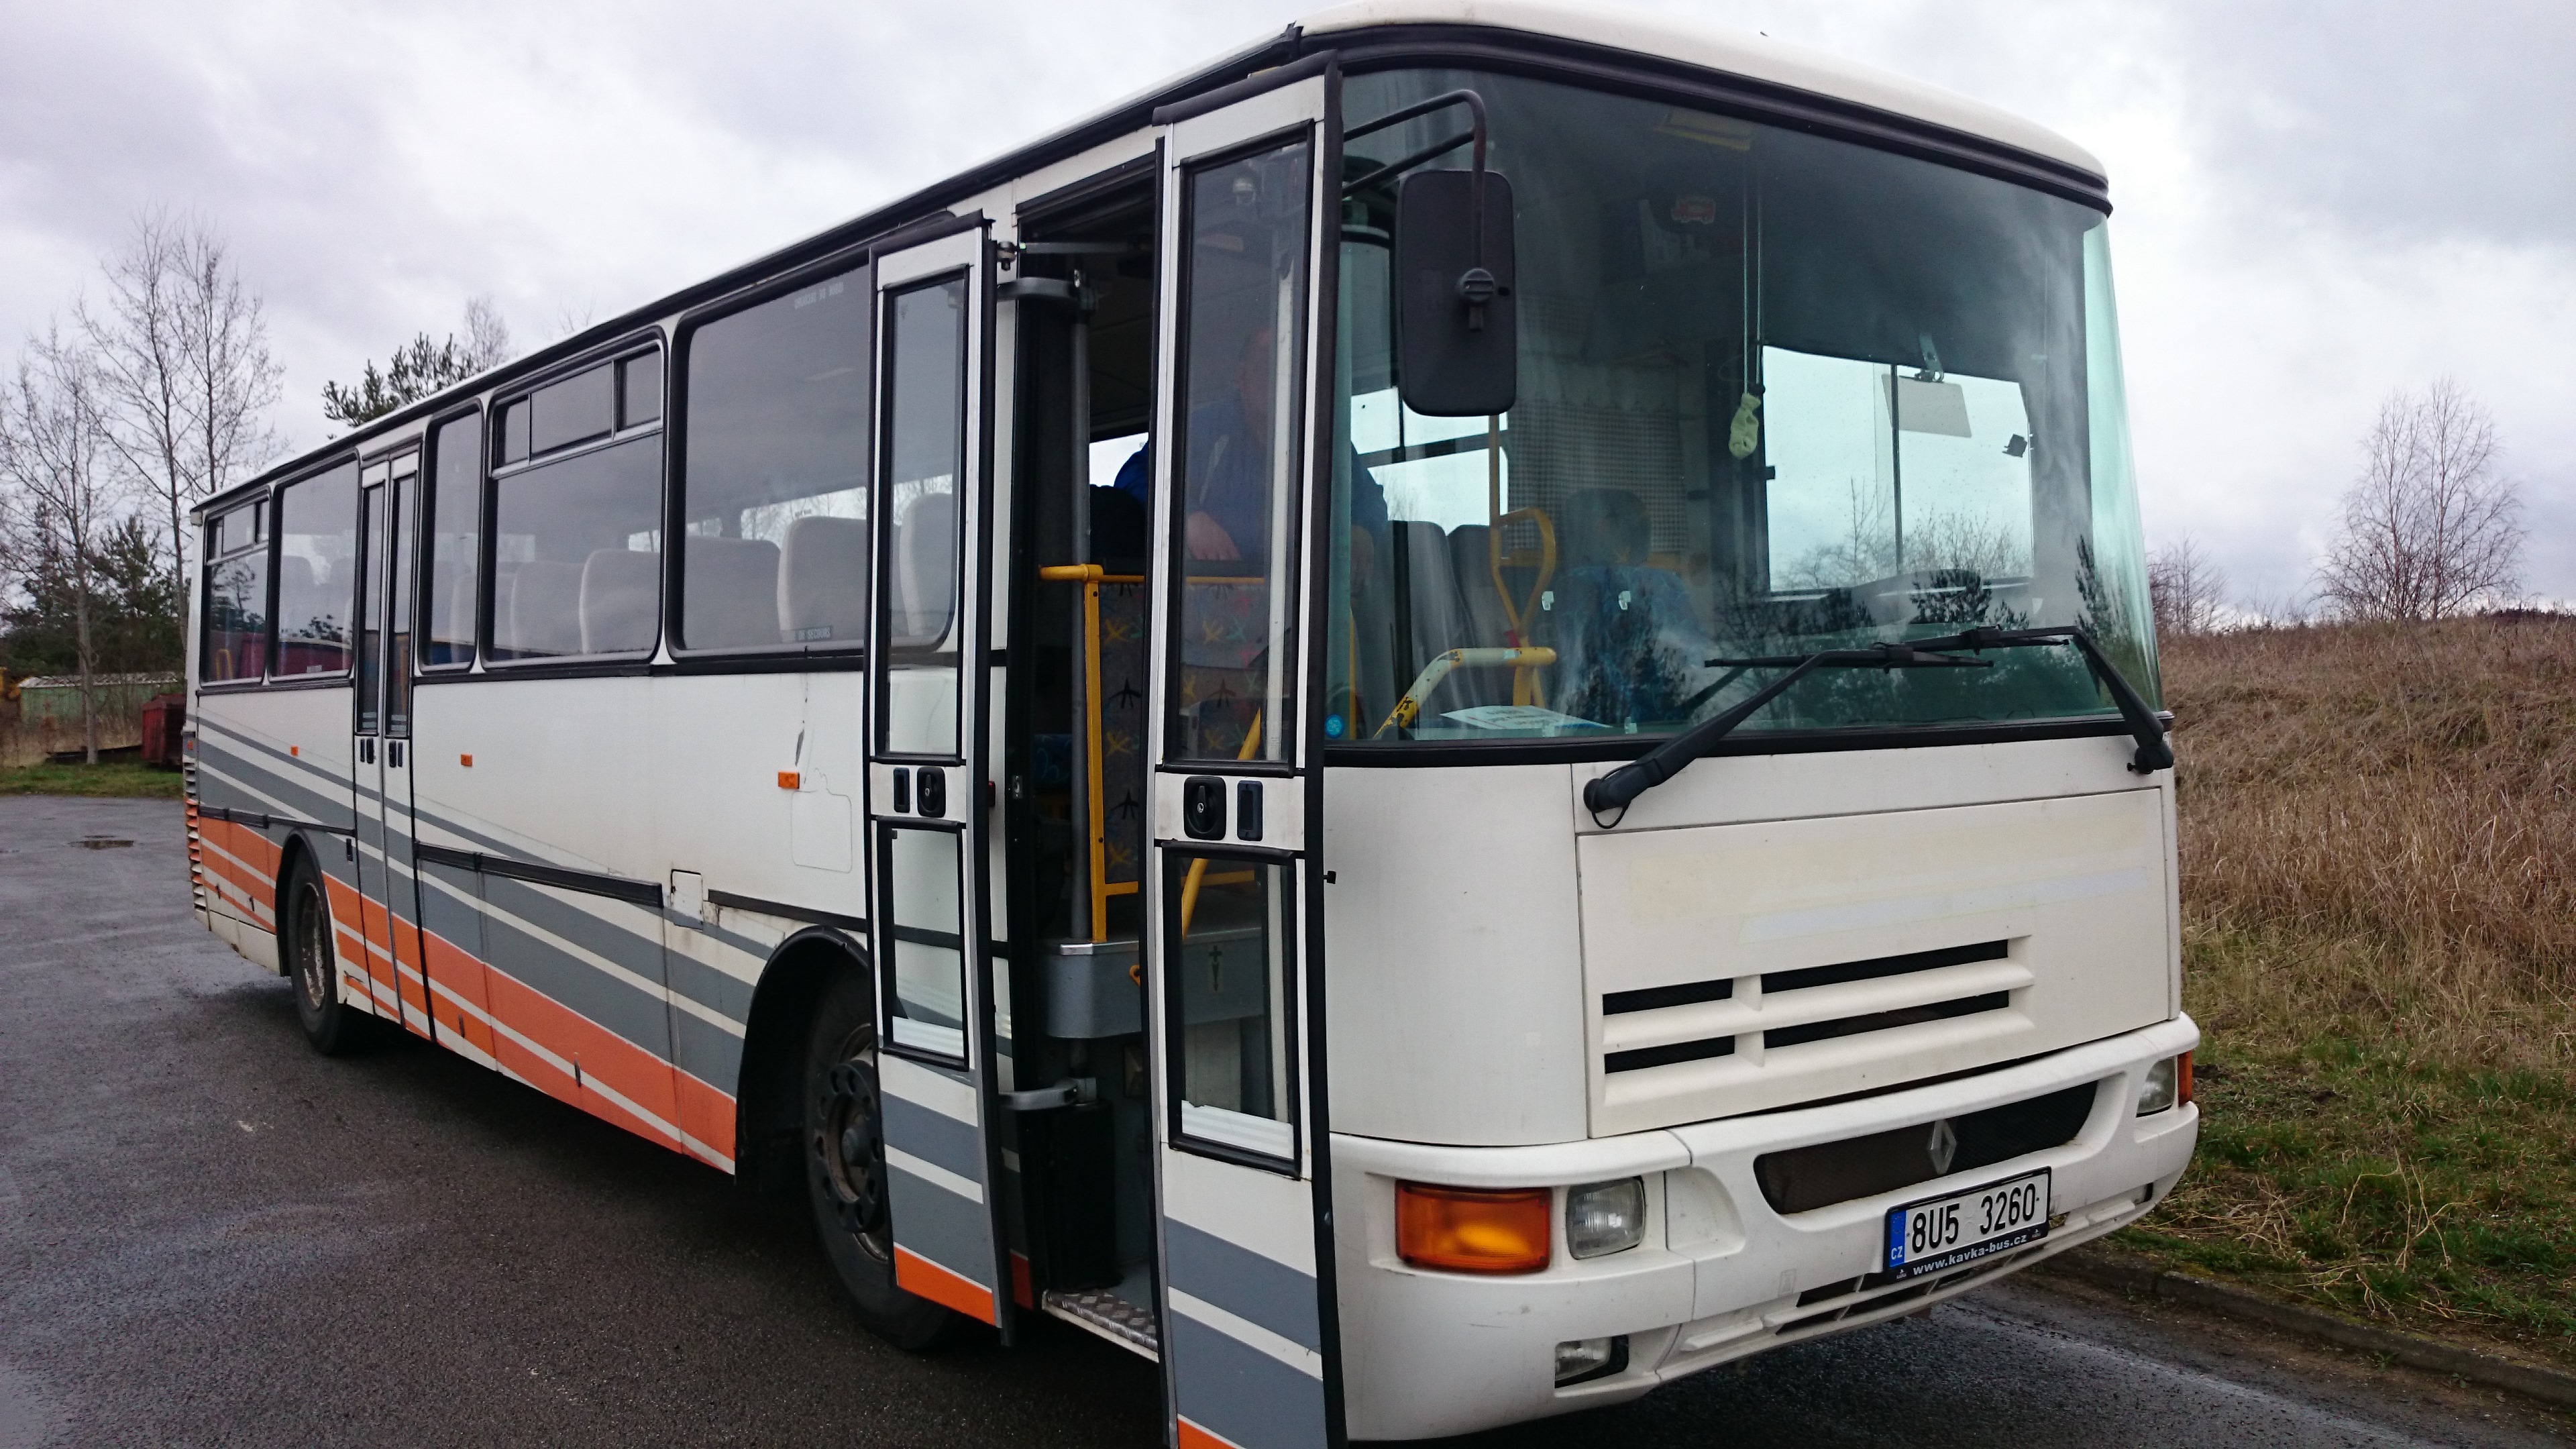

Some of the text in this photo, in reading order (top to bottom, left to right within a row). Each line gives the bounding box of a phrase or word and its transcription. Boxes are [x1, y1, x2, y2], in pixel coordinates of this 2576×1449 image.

[1912, 1183, 2036, 1253] 8U5 3260
[1890, 1245, 1903, 1260] CZ
[1913, 1234, 2027, 1276] www.kavka-bus.cz
